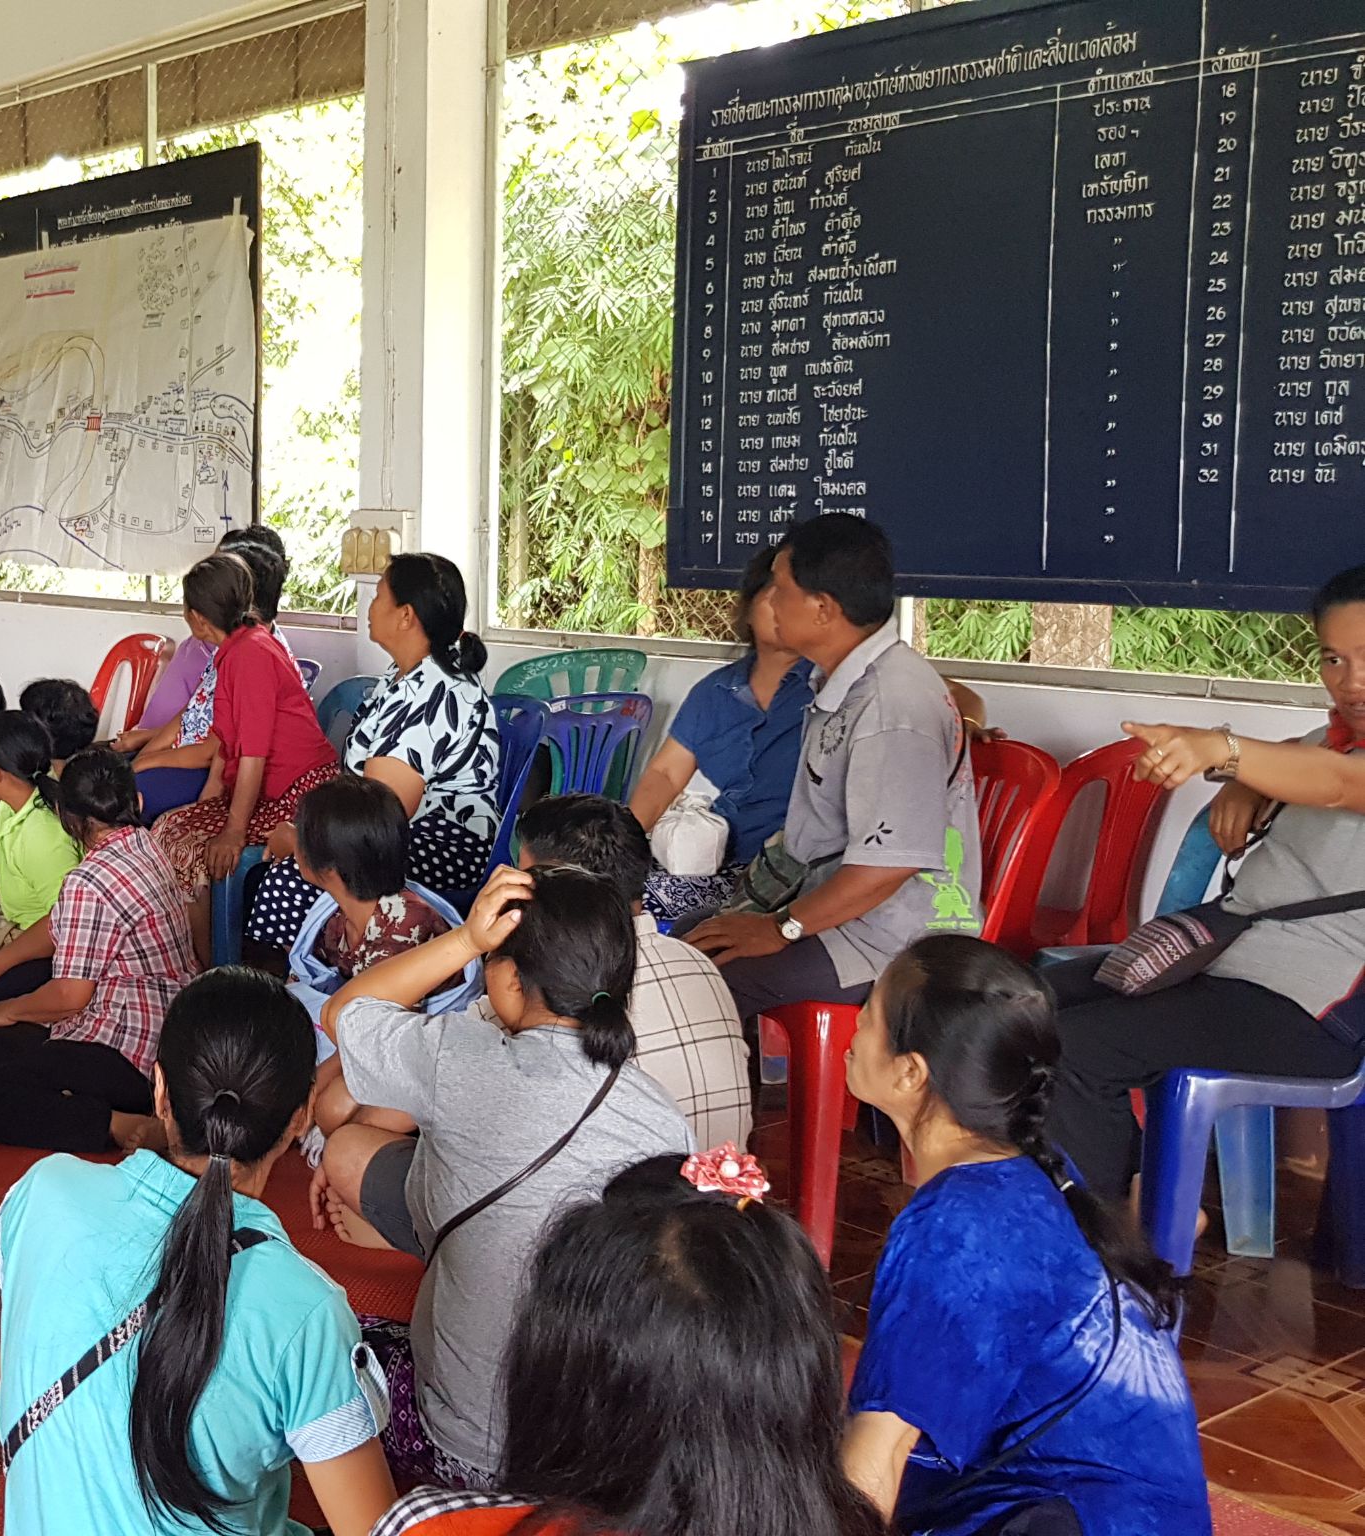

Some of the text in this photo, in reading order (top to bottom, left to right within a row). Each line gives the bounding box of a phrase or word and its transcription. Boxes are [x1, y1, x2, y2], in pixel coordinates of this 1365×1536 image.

[1222, 83, 1236, 98] 18
[1300, 68, 1338, 87] นาย
[1220, 97, 1334, 126] 19 นาย
[1218, 138, 1237, 153] 20
[1296, 126, 1329, 143] นาย
[1214, 167, 1230, 182] 21
[1292, 156, 1324, 174] นาย
[708, 189, 717, 203] 2
[745, 181, 767, 197] นาย
[1212, 195, 1232, 209] 22
[1290, 184, 1325, 201] นาย
[708, 211, 717, 224] 3
[746, 204, 768, 219] นาย
[1211, 223, 1231, 236] 23
[1290, 212, 1325, 230] นาย
[705, 258, 715, 271] 5
[744, 252, 766, 266] นาย
[1086, 202, 1155, 224] กรรมการ
[705, 235, 715, 247] 4
[1209, 252, 1229, 265] 24
[1287, 243, 1322, 259] นาย
[705, 282, 714, 295] 6
[742, 276, 764, 290] นาย
[1207, 279, 1226, 292] 25
[1284, 271, 1318, 287] นาย
[705, 304, 714, 317] 7
[741, 299, 762, 314] นาย
[1206, 307, 1226, 321] 26
[1282, 300, 1313, 315] นาย
[704, 326, 712, 339] 8
[1204, 334, 1226, 347] 27
[1281, 328, 1315, 344] นาย
[702, 349, 711, 361] 9
[740, 345, 762, 358] นาย
[1203, 358, 1223, 371] 28
[1279, 355, 1310, 371] นาย
[702, 371, 712, 384] 10
[740, 367, 761, 381] นาย
[702, 395, 712, 406] 11
[739, 390, 762, 404] นาย
[1203, 385, 1224, 400] 29
[1278, 381, 1312, 397] นาย
[701, 418, 712, 430] 12
[738, 414, 760, 427] นาย
[1202, 413, 1223, 428] 30
[1274, 411, 1306, 426] นาย
[701, 441, 713, 452] 13
[740, 437, 763, 450] นาย
[1200, 443, 1218, 456] 31
[1274, 442, 1305, 456] นาย
[701, 462, 712, 474] 14
[738, 460, 761, 473] นาย
[1198, 469, 1219, 483] 32
[1269, 469, 1304, 483] นาย
[701, 485, 713, 497] 15
[737, 485, 761, 498] นาย
[701, 511, 713, 522] 16
[737, 510, 760, 522] นาย
[701, 533, 713, 545] 17
[736, 532, 759, 544] นาย
